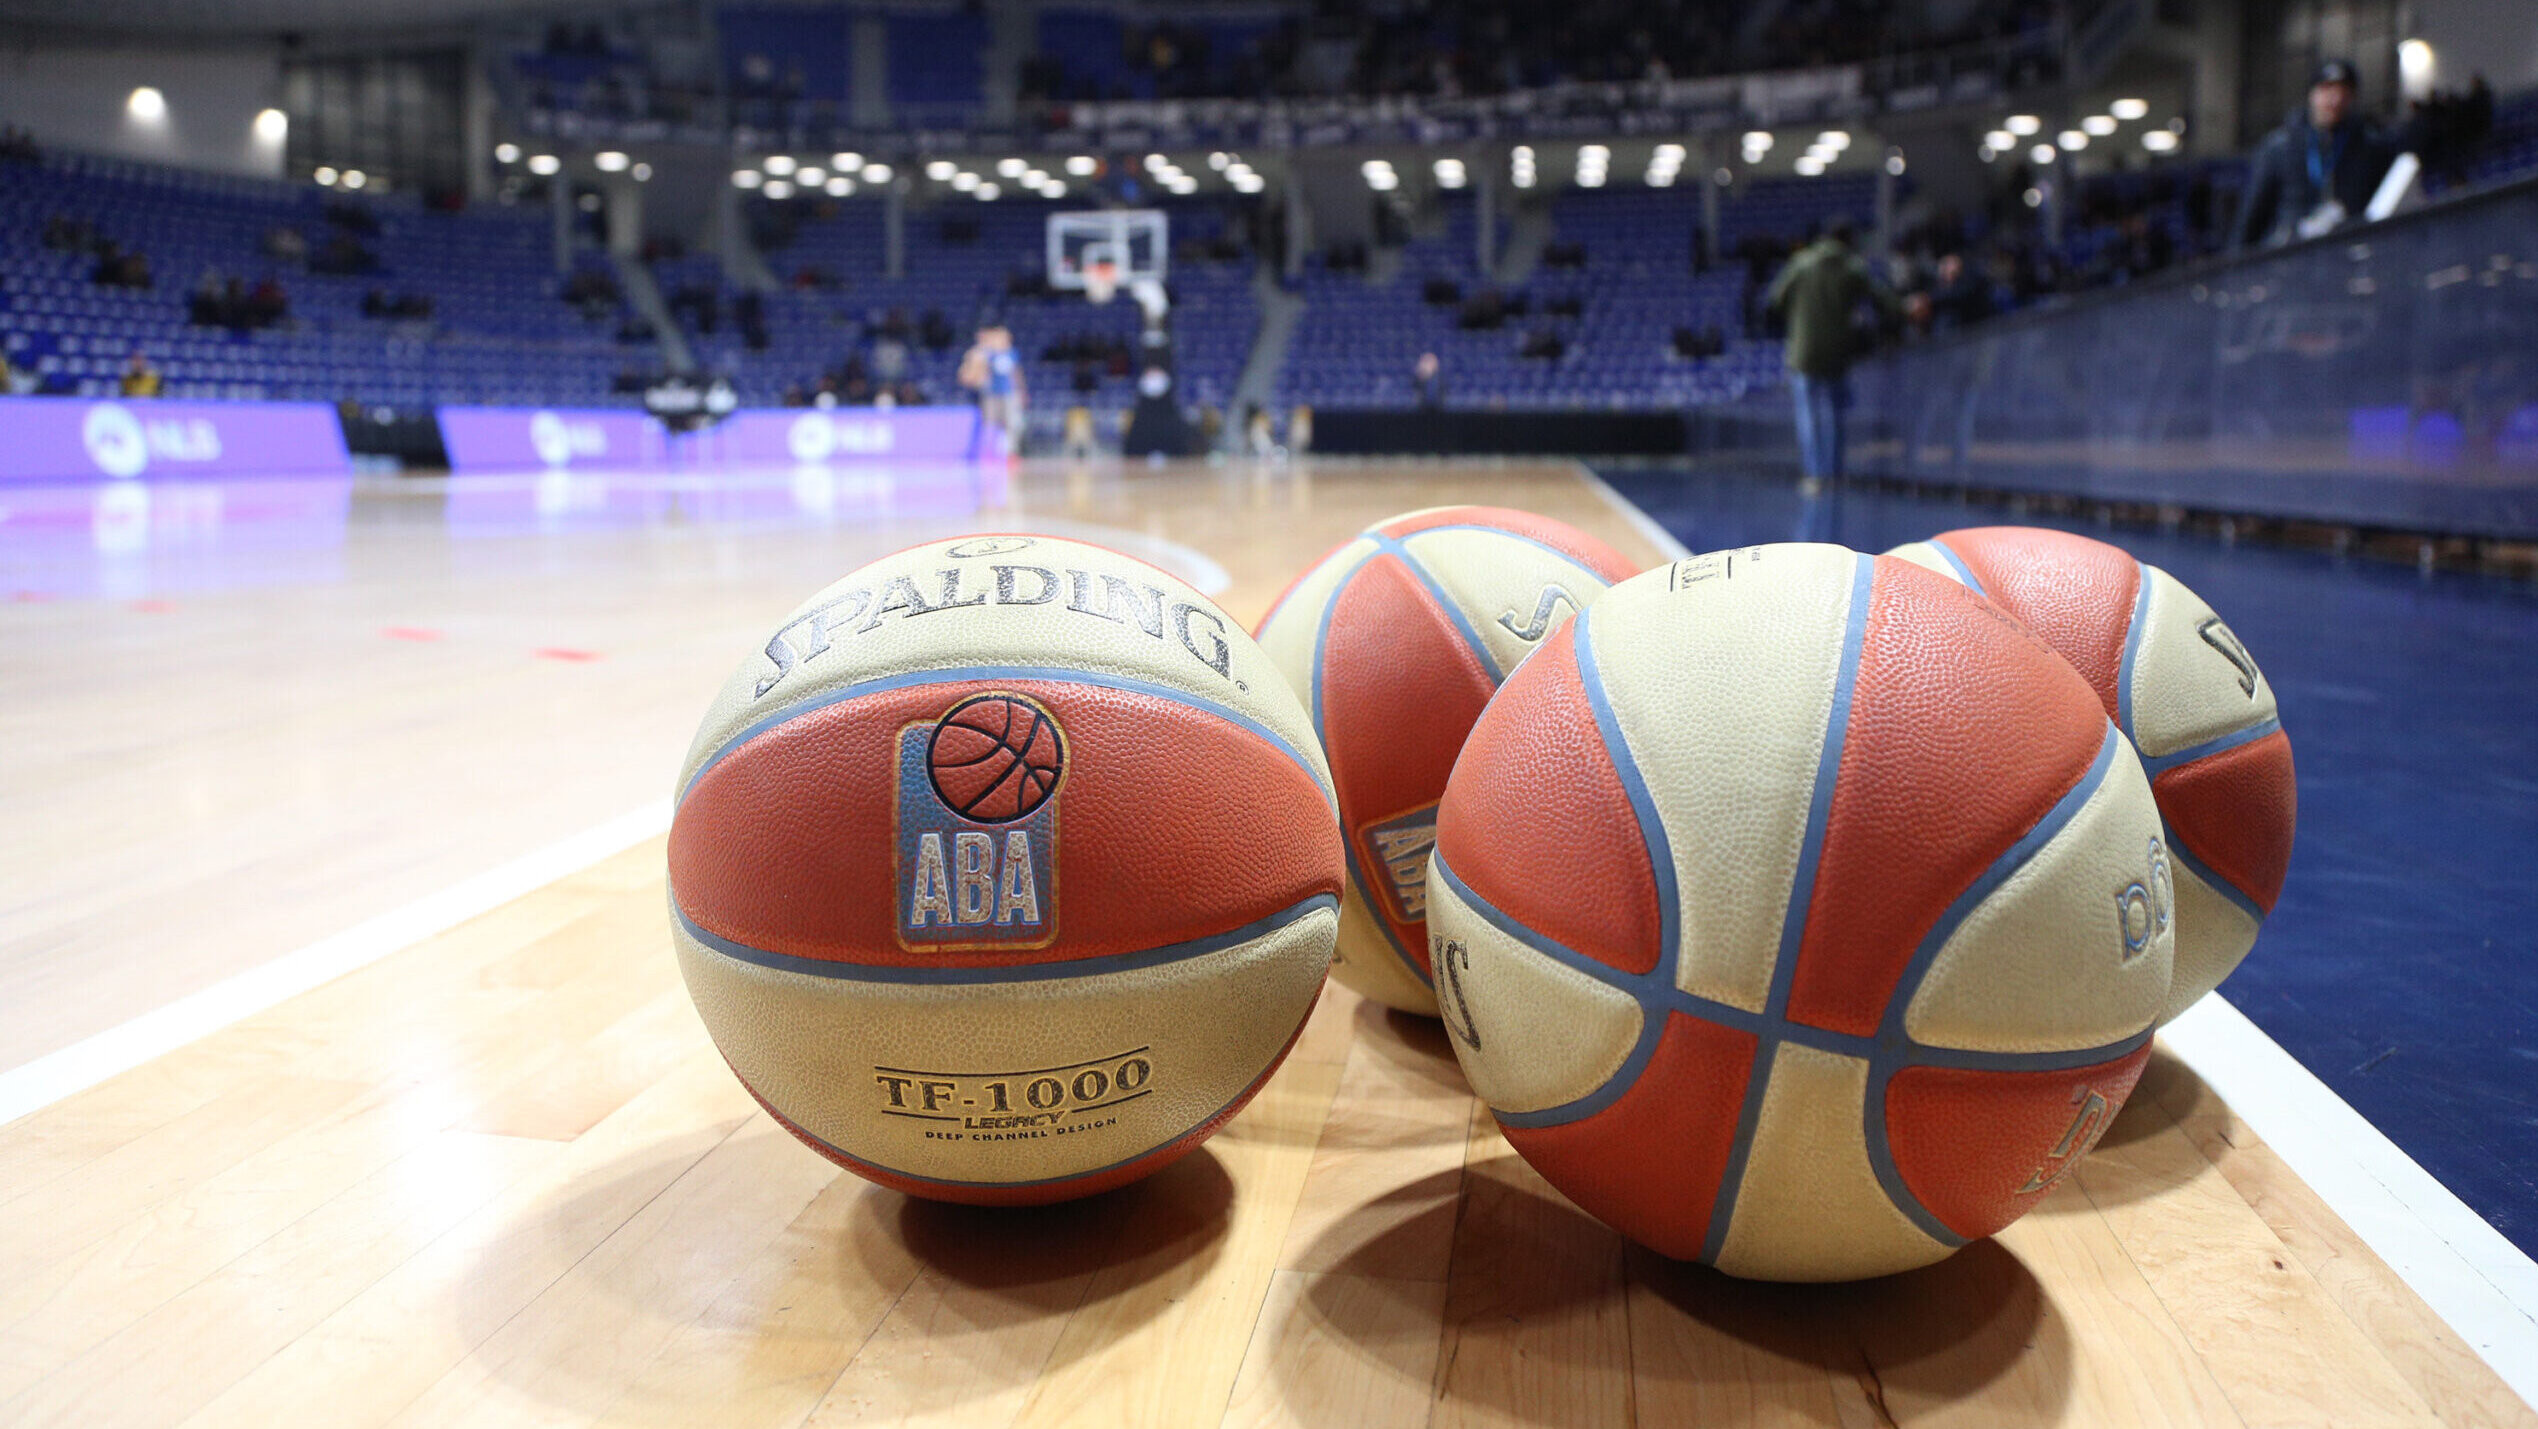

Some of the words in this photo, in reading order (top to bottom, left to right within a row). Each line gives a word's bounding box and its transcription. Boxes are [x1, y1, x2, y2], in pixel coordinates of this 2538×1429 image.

[754, 564, 1233, 699] SPALDING
[910, 830, 1041, 926] ABA
[876, 1058, 1151, 1113] TF-1000
[924, 1130, 964, 1142] DEEP
[972, 1129, 1048, 1142] CHANNEL
[1056, 1116, 1118, 1136] DESIGN
[963, 1109, 1067, 1130] LEGACY
